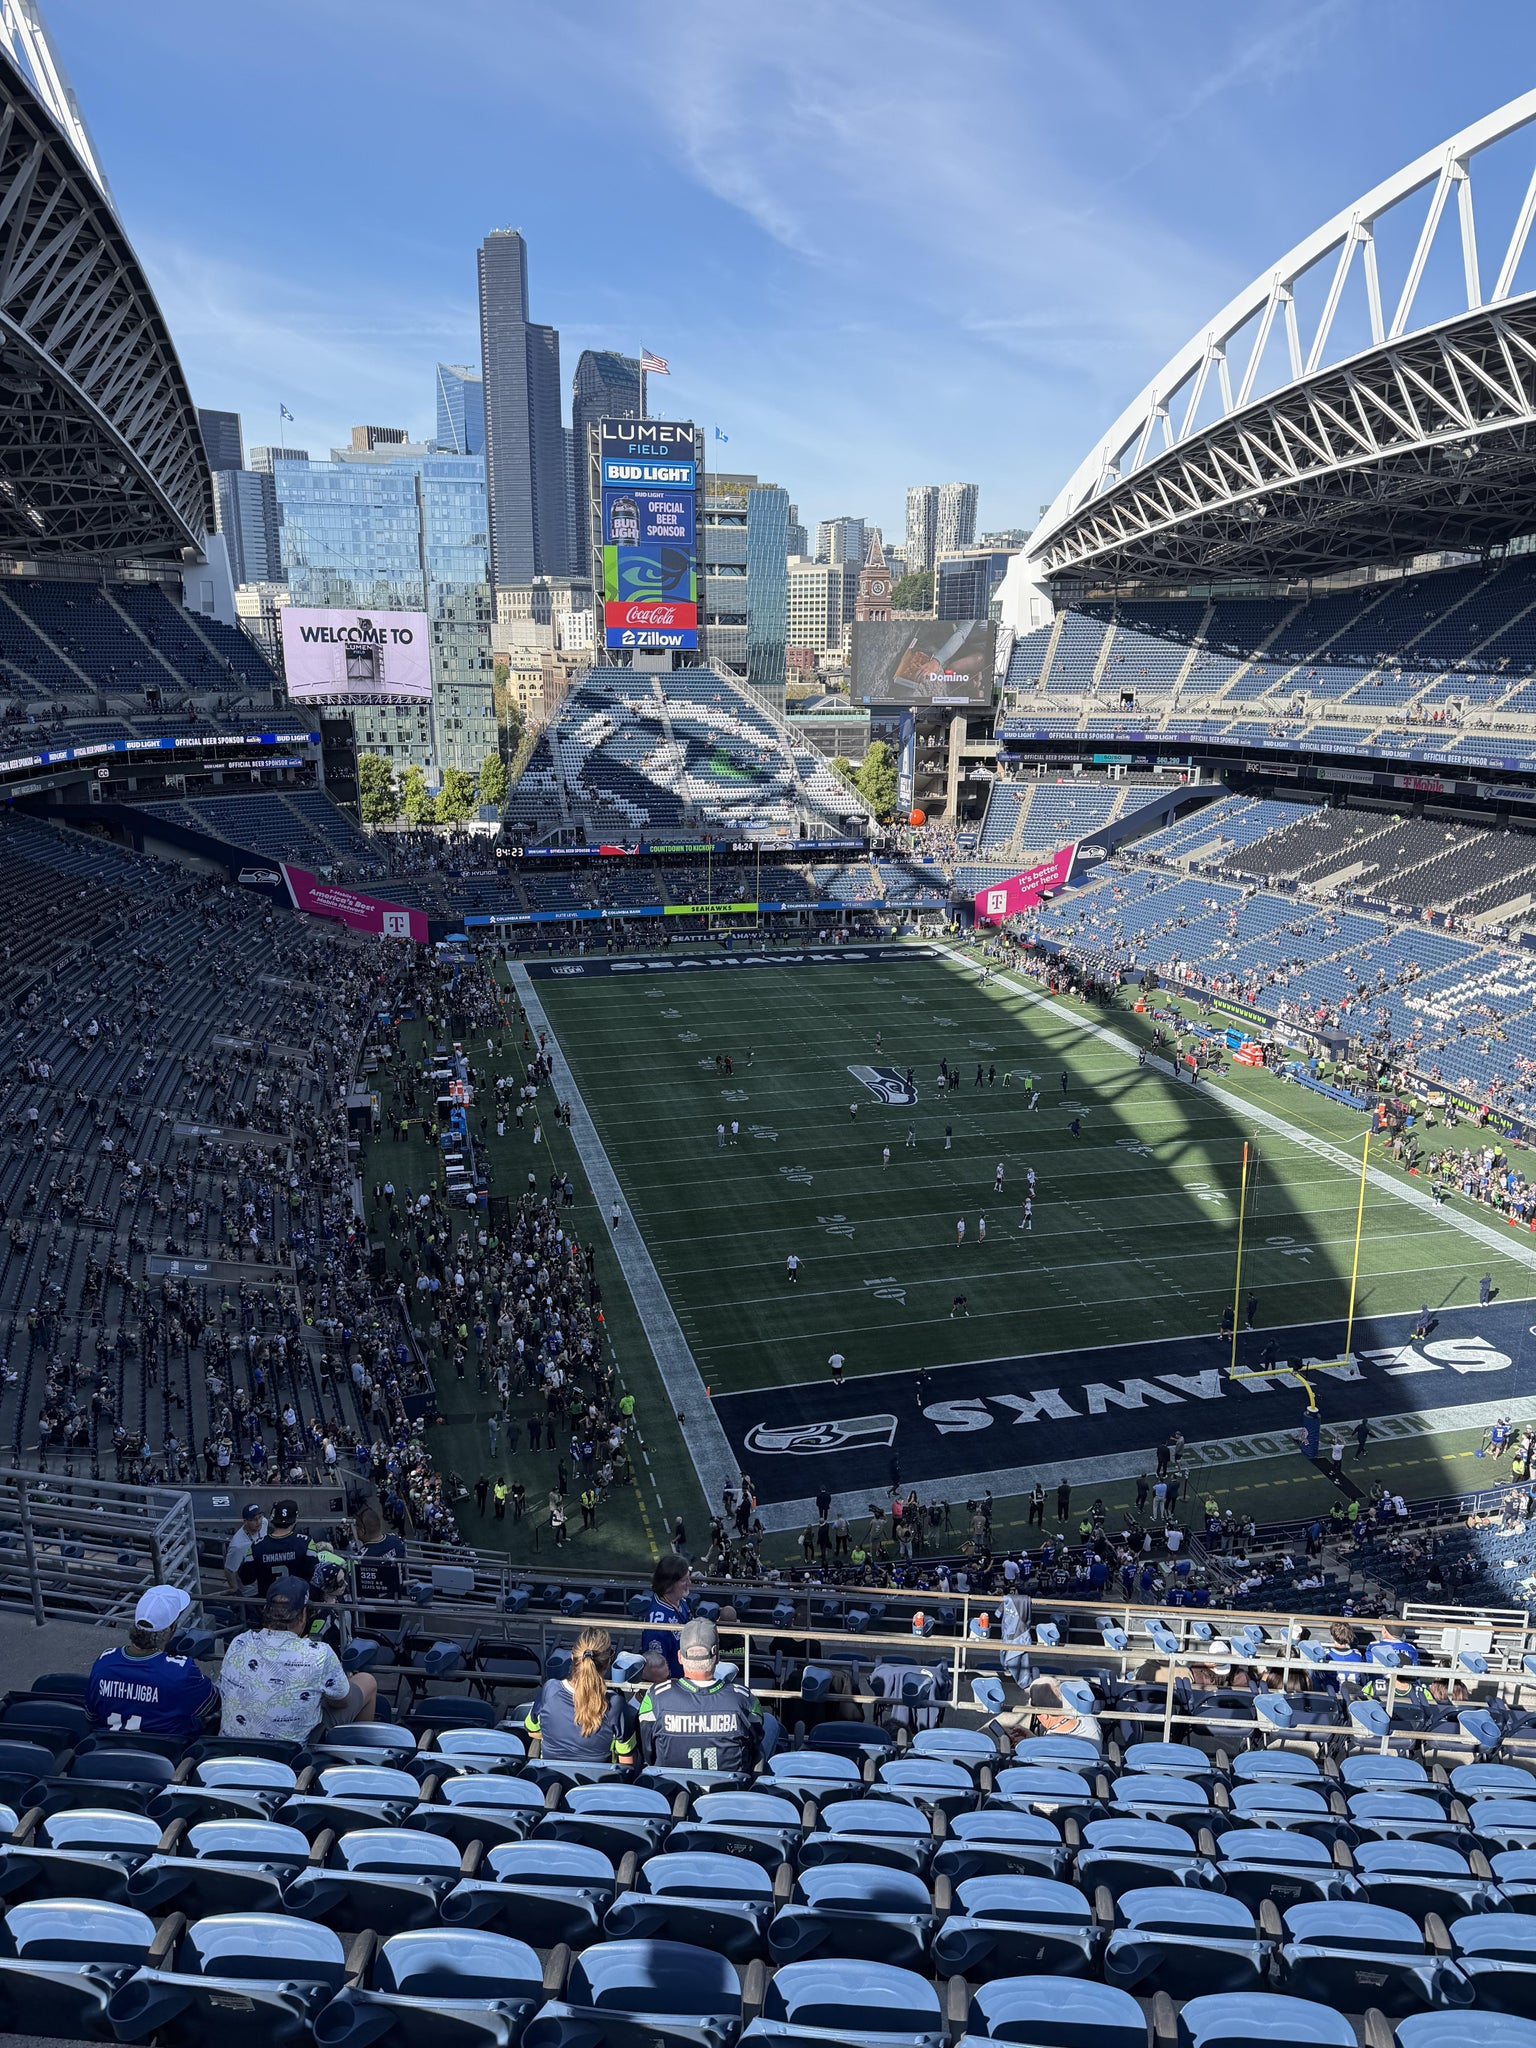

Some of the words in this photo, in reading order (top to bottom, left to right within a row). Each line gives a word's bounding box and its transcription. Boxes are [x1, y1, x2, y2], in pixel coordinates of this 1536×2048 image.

[603, 424, 693, 442] LUMEN
[629, 444, 668, 455] FIELD
[608, 466, 642, 480] BUD
[643, 467, 690, 481] LIGHT
[648, 502, 684, 513] OFFICIAL
[614, 519, 637, 528] BUD
[656, 514, 677, 524] BEER
[611, 529, 639, 538] LIGHT
[647, 525, 685, 536] SPONSOR
[626, 605, 676, 624] Coca-Cola
[300, 626, 387, 644] WELCOME
[391, 628, 413, 644] TO
[637, 631, 684, 645] Zillow
[930, 672, 969, 682] Domino
[175, 737, 201, 746] OFFICIAL
[203, 737, 217, 745] BEER
[218, 736, 244, 744] SPONSOR
[1089, 732, 1114, 740] SPONSOR
[141, 740, 160, 748] LIGHT
[1300, 742, 1320, 750] OFFICIAL
[1321, 743, 1332, 751] BEER
[1334, 744, 1355, 753] SPONSOR
[228, 761, 251, 769] OFFICIAL
[265, 759, 288, 767] SPONSOR
[1423, 753, 1446, 762] OFFICIAL
[1448, 754, 1461, 763] BEER
[1462, 756, 1487, 765] SPONSOR
[99, 769, 109, 777] CC
[1496, 790, 1535, 800] BOEING
[650, 845, 684, 853] COUNTDOWN
[685, 844, 692, 852] TO
[732, 842, 753, 851] 84:24
[496, 847, 524, 858] 84:23
[1019, 872, 1032, 885] It's
[1033, 863, 1059, 879] better
[1021, 880, 1039, 893] over
[1040, 872, 1059, 885] here
[309, 888, 353, 906] America's
[355, 901, 375, 912] Best
[317, 897, 337, 906] Mobile
[338, 904, 365, 914] Network
[671, 934, 715, 942] SEATTLE
[610, 953, 870, 971] SEAHAWKS
[922, 1336, 1513, 1435] SEAHAWKS
[281, 1508, 288, 1516] S
[262, 1551, 296, 1564] EMMANWORI
[1057, 1576, 1066, 1584] 37
[650, 1611, 665, 1623] 12
[99, 1678, 159, 1704] SMITH-NJIGBA
[664, 1713, 737, 1733] SMITH-NJIGBA
[688, 1747, 718, 1771] 11
